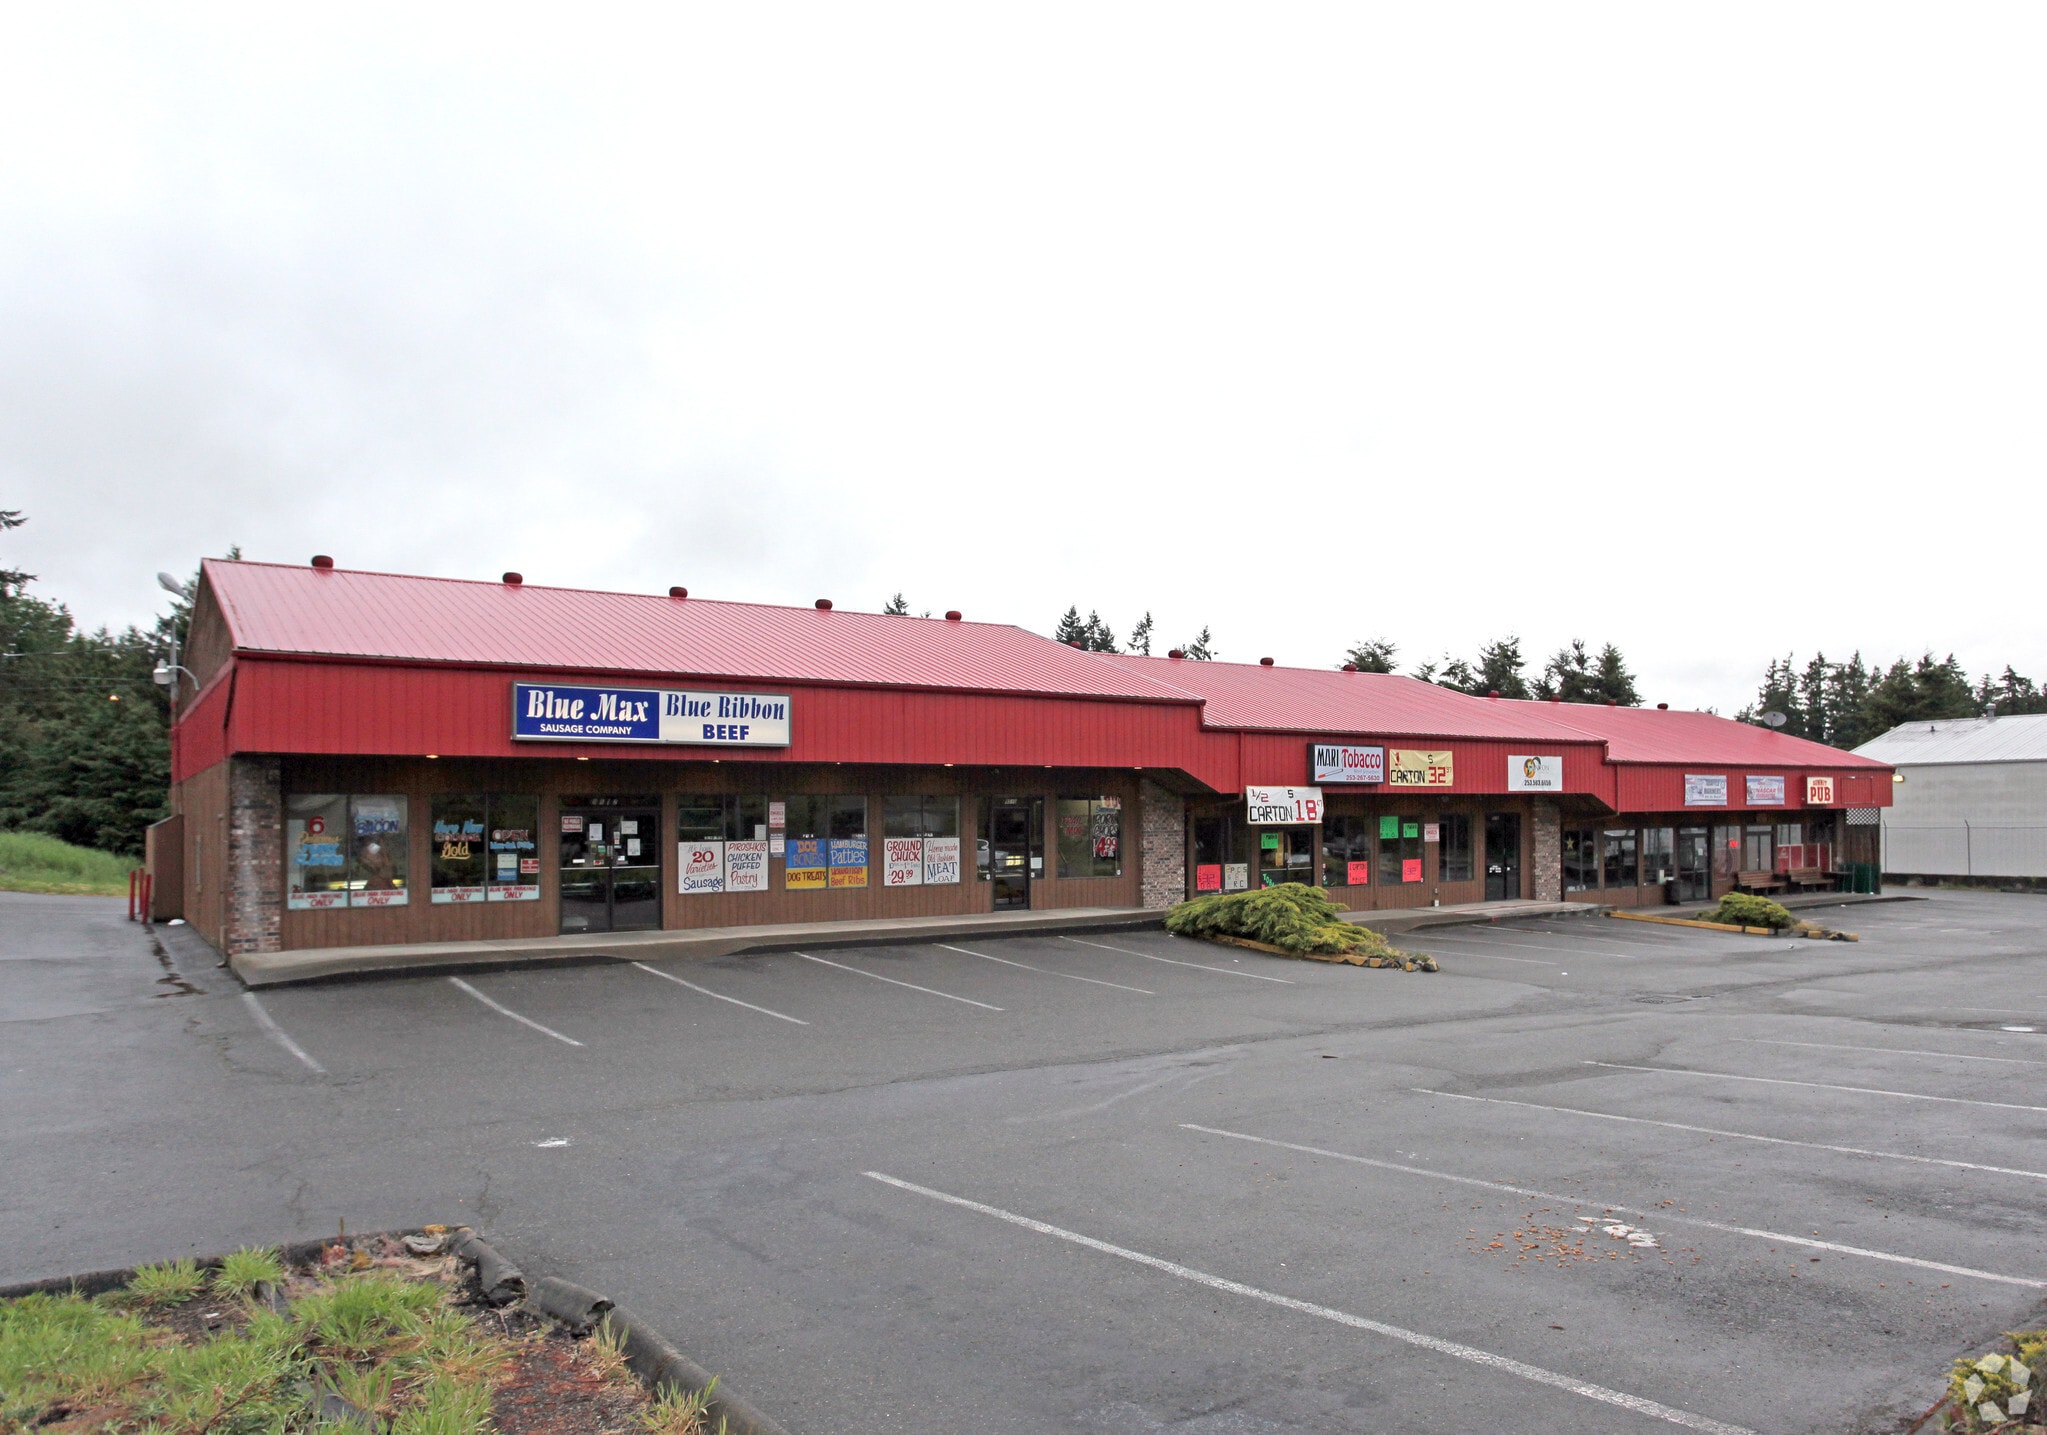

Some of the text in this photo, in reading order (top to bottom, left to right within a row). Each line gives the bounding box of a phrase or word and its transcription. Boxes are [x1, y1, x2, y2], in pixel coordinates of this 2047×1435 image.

[526, 689, 648, 723] Blue Max
[665, 693, 785, 721] Blue Ribbon
[540, 723, 632, 735] SAUSAGE COMPANY
[702, 724, 749, 740] BEEF
[1317, 746, 1381, 769] MARI Tobacco
[1390, 770, 1425, 783] CARTON
[1428, 766, 1446, 783] 32
[1810, 786, 1831, 801] PUB
[1249, 806, 1293, 821] CARTON
[1295, 799, 1317, 821] 18
[308, 815, 325, 834] 6
[355, 820, 399, 836] BACON
[492, 829, 529, 841] OPEN
[441, 841, 470, 859] Gold
[728, 842, 766, 852] PIROSHKIS
[797, 841, 817, 853] DOG
[831, 840, 867, 850] HAMBURGER
[886, 840, 922, 852] GROUND
[692, 850, 715, 863] 20
[727, 853, 762, 862] CHICKEN
[793, 853, 824, 866] BONES
[831, 850, 865, 865] Patties
[891, 851, 920, 862] CHUCK
[686, 862, 718, 874] Varieties
[732, 862, 760, 870] PUFFED
[927, 862, 957, 880] MEAT
[730, 871, 758, 888] Pastry
[787, 871, 826, 882] DOG TREATS
[831, 876, 865, 886] Beef Ribs
[683, 877, 723, 891] Sausage
[310, 899, 334, 907] ONLY
[451, 893, 472, 901] ONLY
